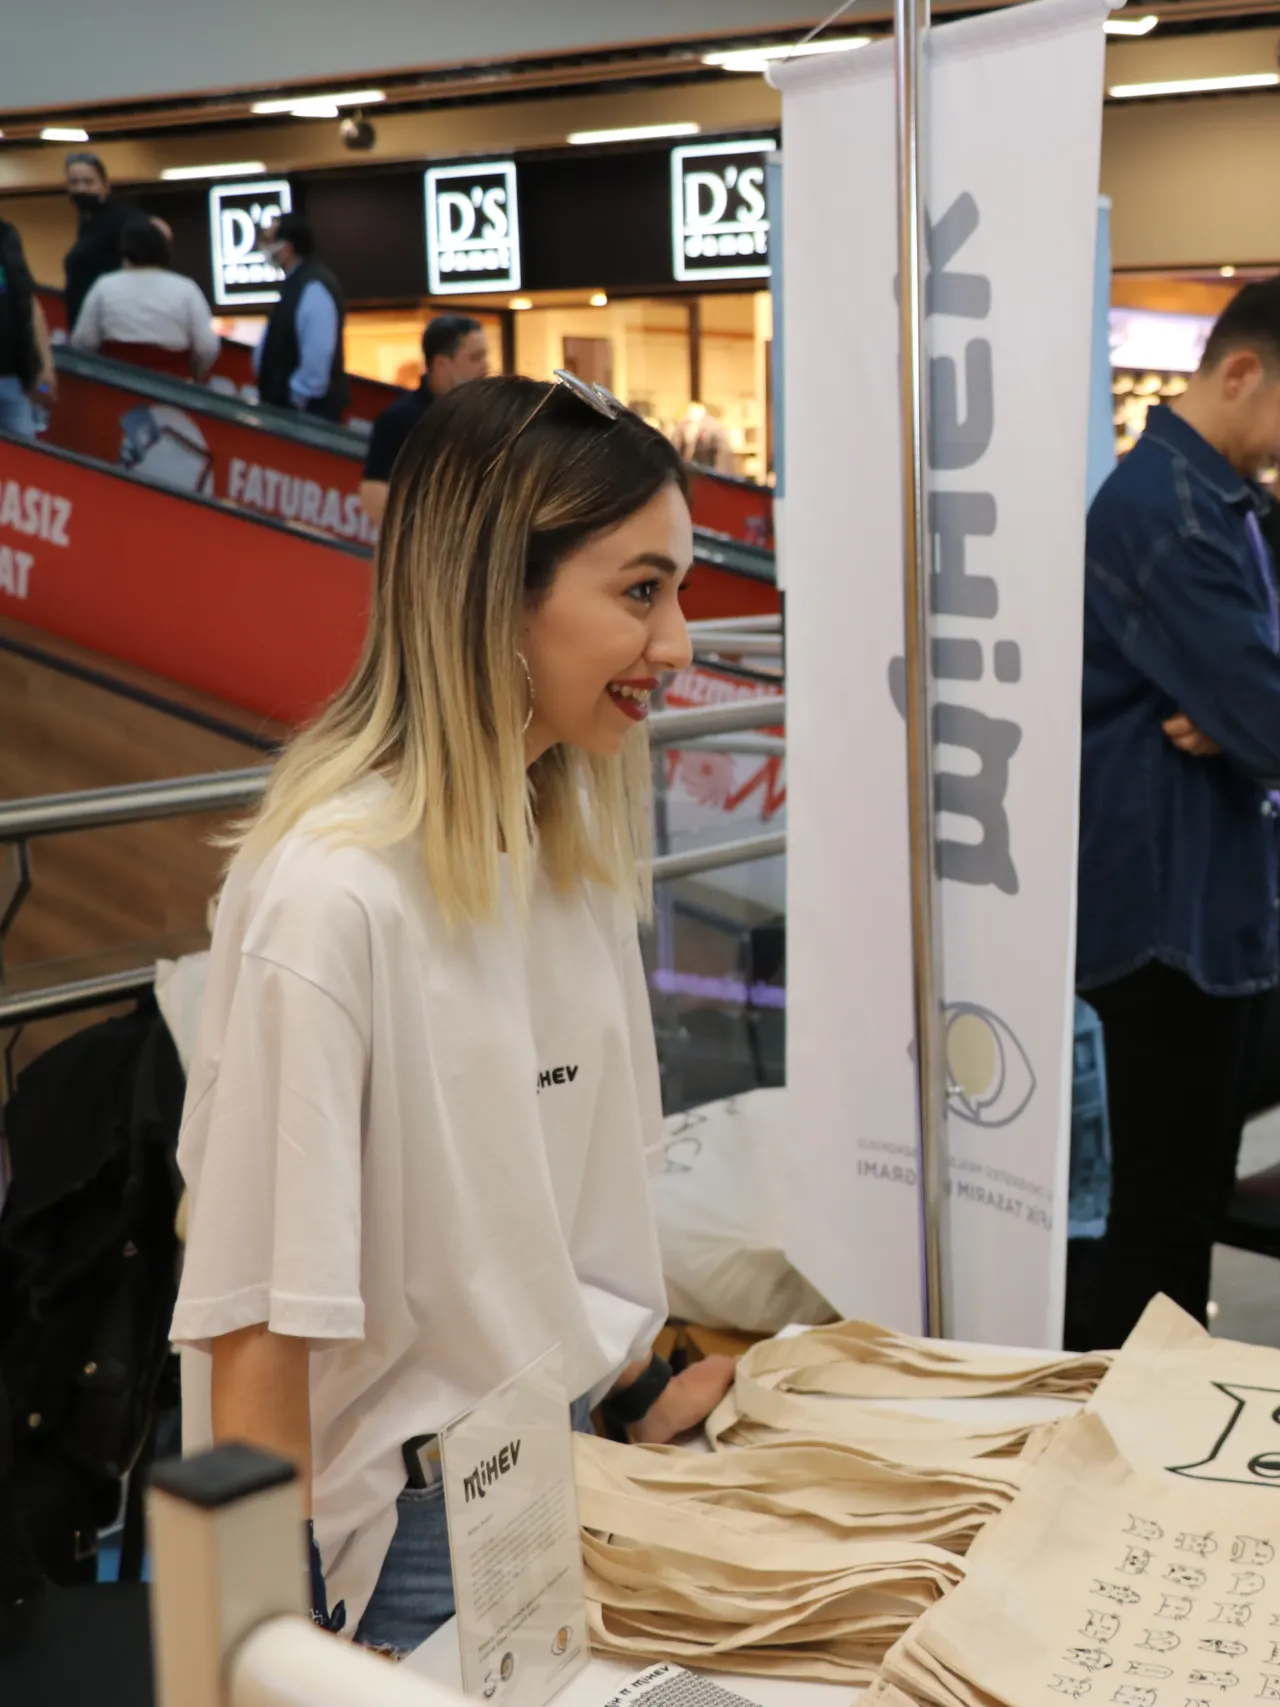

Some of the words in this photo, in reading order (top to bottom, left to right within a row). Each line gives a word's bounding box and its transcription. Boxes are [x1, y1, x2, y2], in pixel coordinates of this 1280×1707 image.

[437, 186, 508, 242] D'S
[684, 165, 766, 224] D'S
[228, 457, 380, 543] FATURASI
